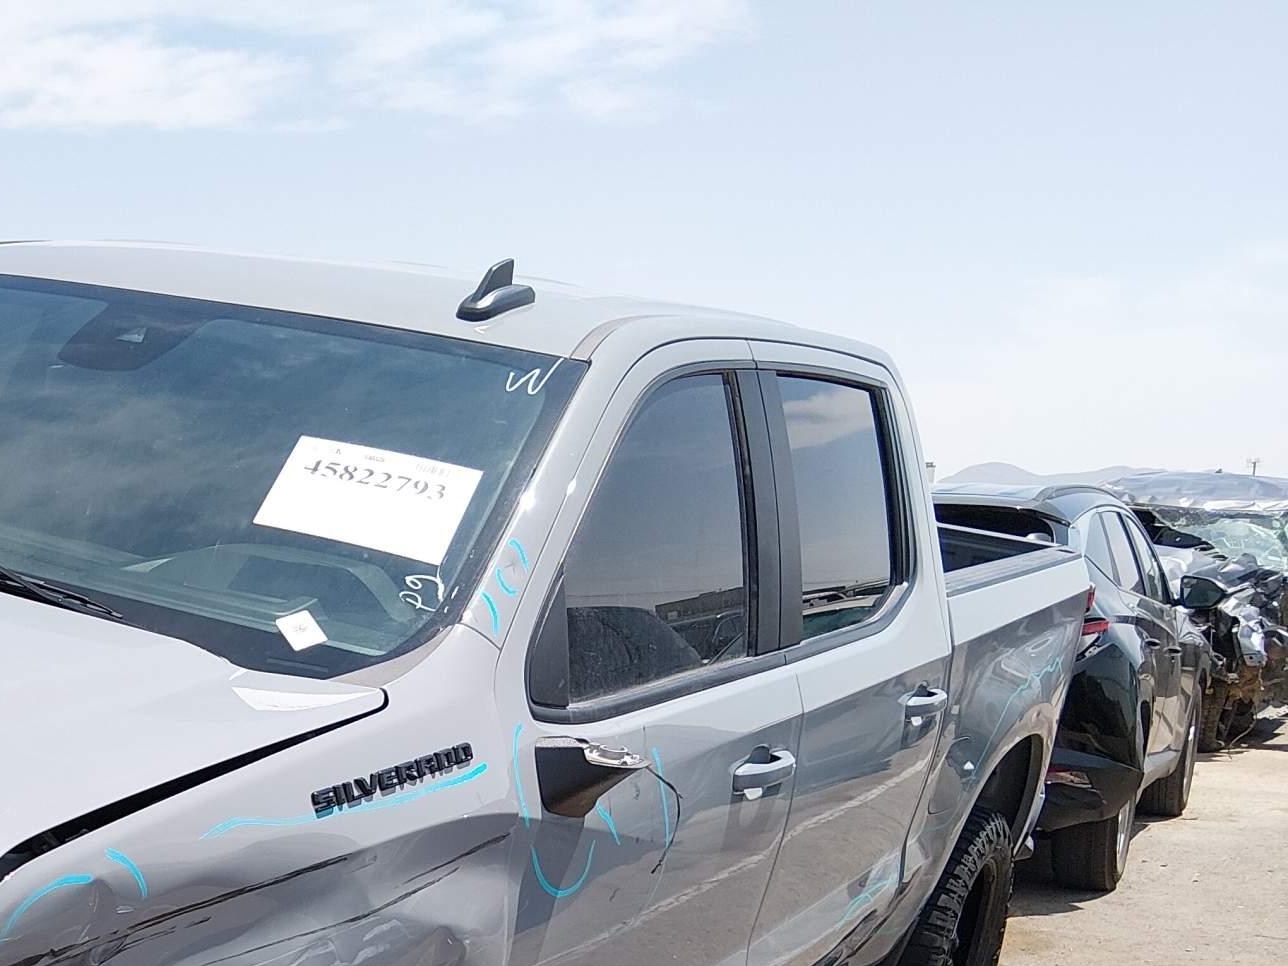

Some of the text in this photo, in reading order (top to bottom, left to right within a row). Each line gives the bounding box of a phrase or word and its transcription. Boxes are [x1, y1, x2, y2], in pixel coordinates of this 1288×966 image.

[505, 357, 564, 395] W
[303, 459, 447, 500] 45822793
[310, 742, 474, 814] SILVERADO
